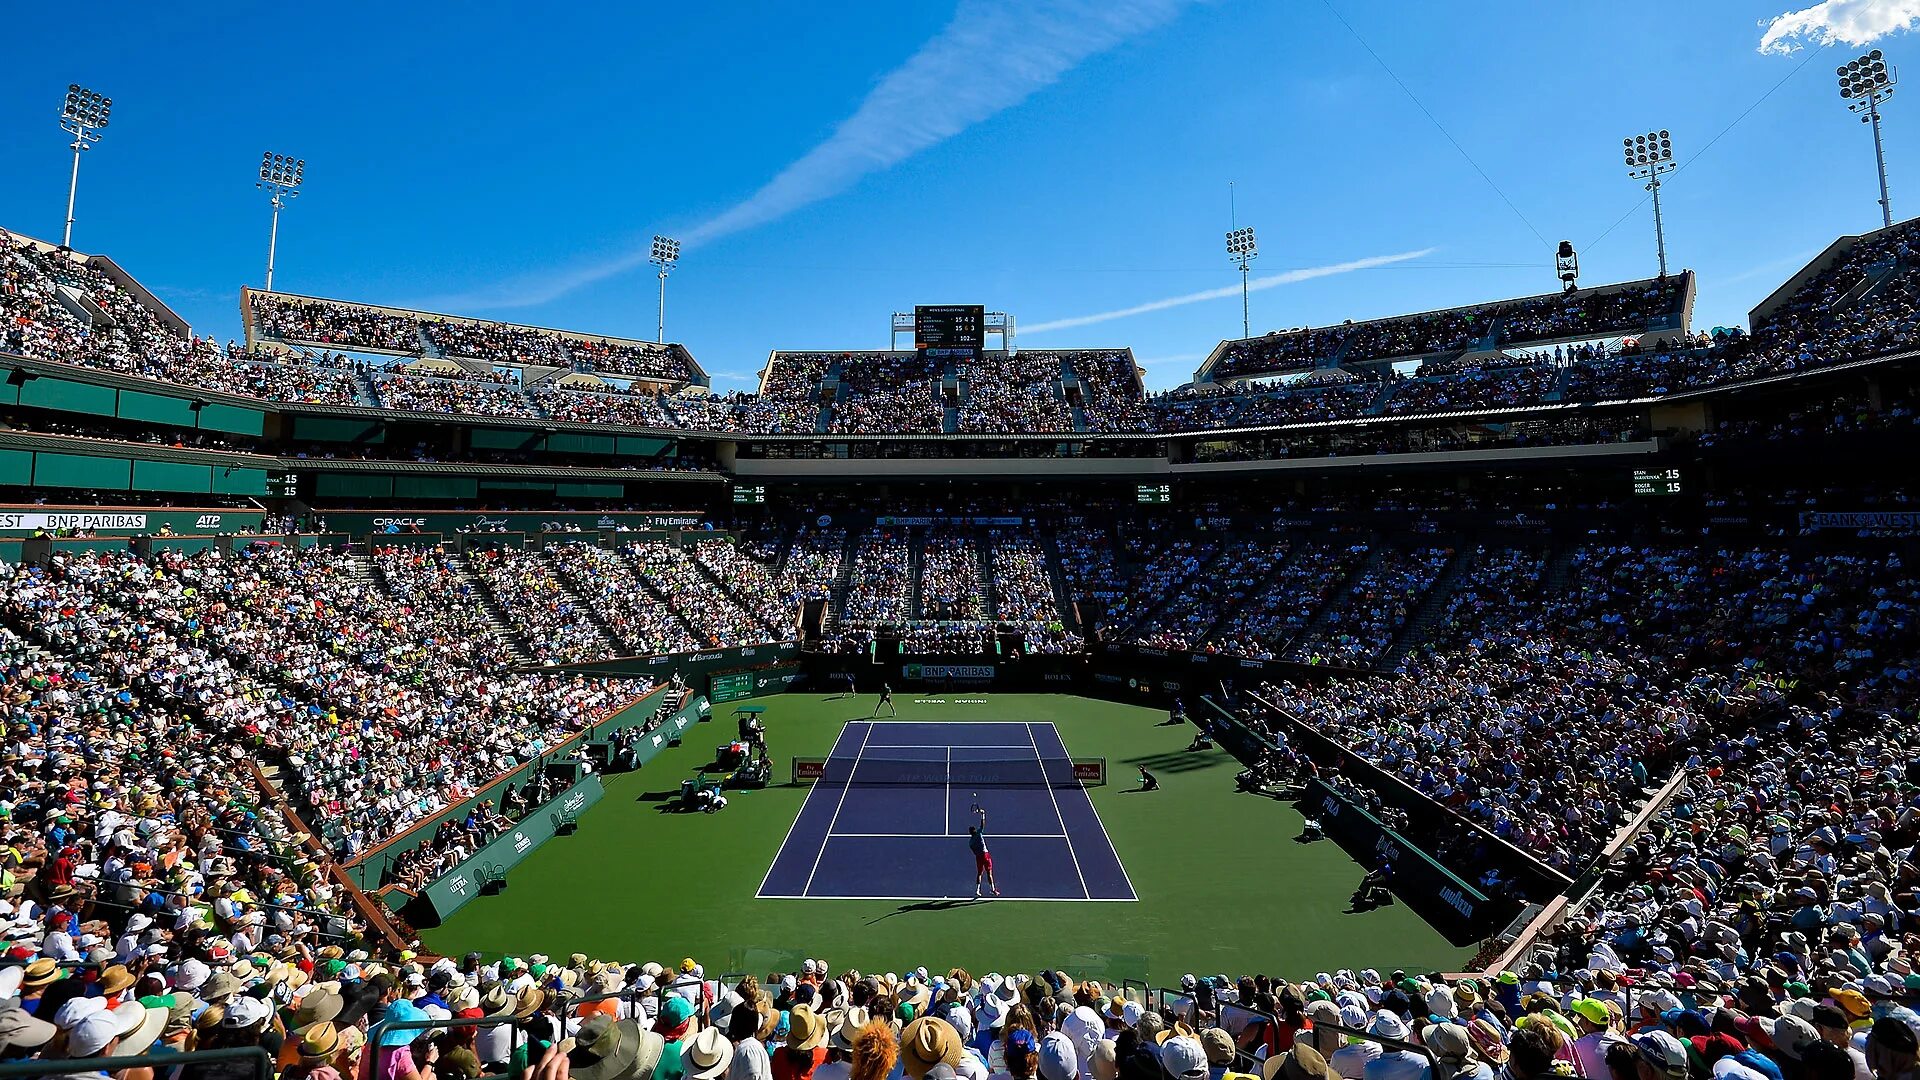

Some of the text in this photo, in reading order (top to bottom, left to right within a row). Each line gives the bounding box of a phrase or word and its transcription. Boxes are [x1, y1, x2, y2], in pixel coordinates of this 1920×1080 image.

[284, 474, 297, 484] 15
[1665, 469, 1680, 479] 15
[284, 486, 297, 496] 15
[755, 486, 765, 494] 15
[1160, 485, 1170, 493] 15
[1666, 482, 1681, 493] 15
[755, 495, 765, 503] 15
[1160, 494, 1170, 502] 15
[46, 515, 142, 527] BNP PARIBAS
[196, 515, 221, 525] ATP
[373, 518, 425, 526] ORACLE
[655, 516, 698, 527] Fly Emirates
[1207, 516, 1231, 525] Hertz
[779, 642, 795, 650] WTA
[1138, 647, 1169, 657] ORACLE
[1240, 659, 1263, 669] ESPN
[925, 667, 990, 676] BNP PARIBAS
[1044, 673, 1072, 681] ROLEX
[1322, 795, 1341, 817] FILA
[449, 878, 469, 894] ULTRA
